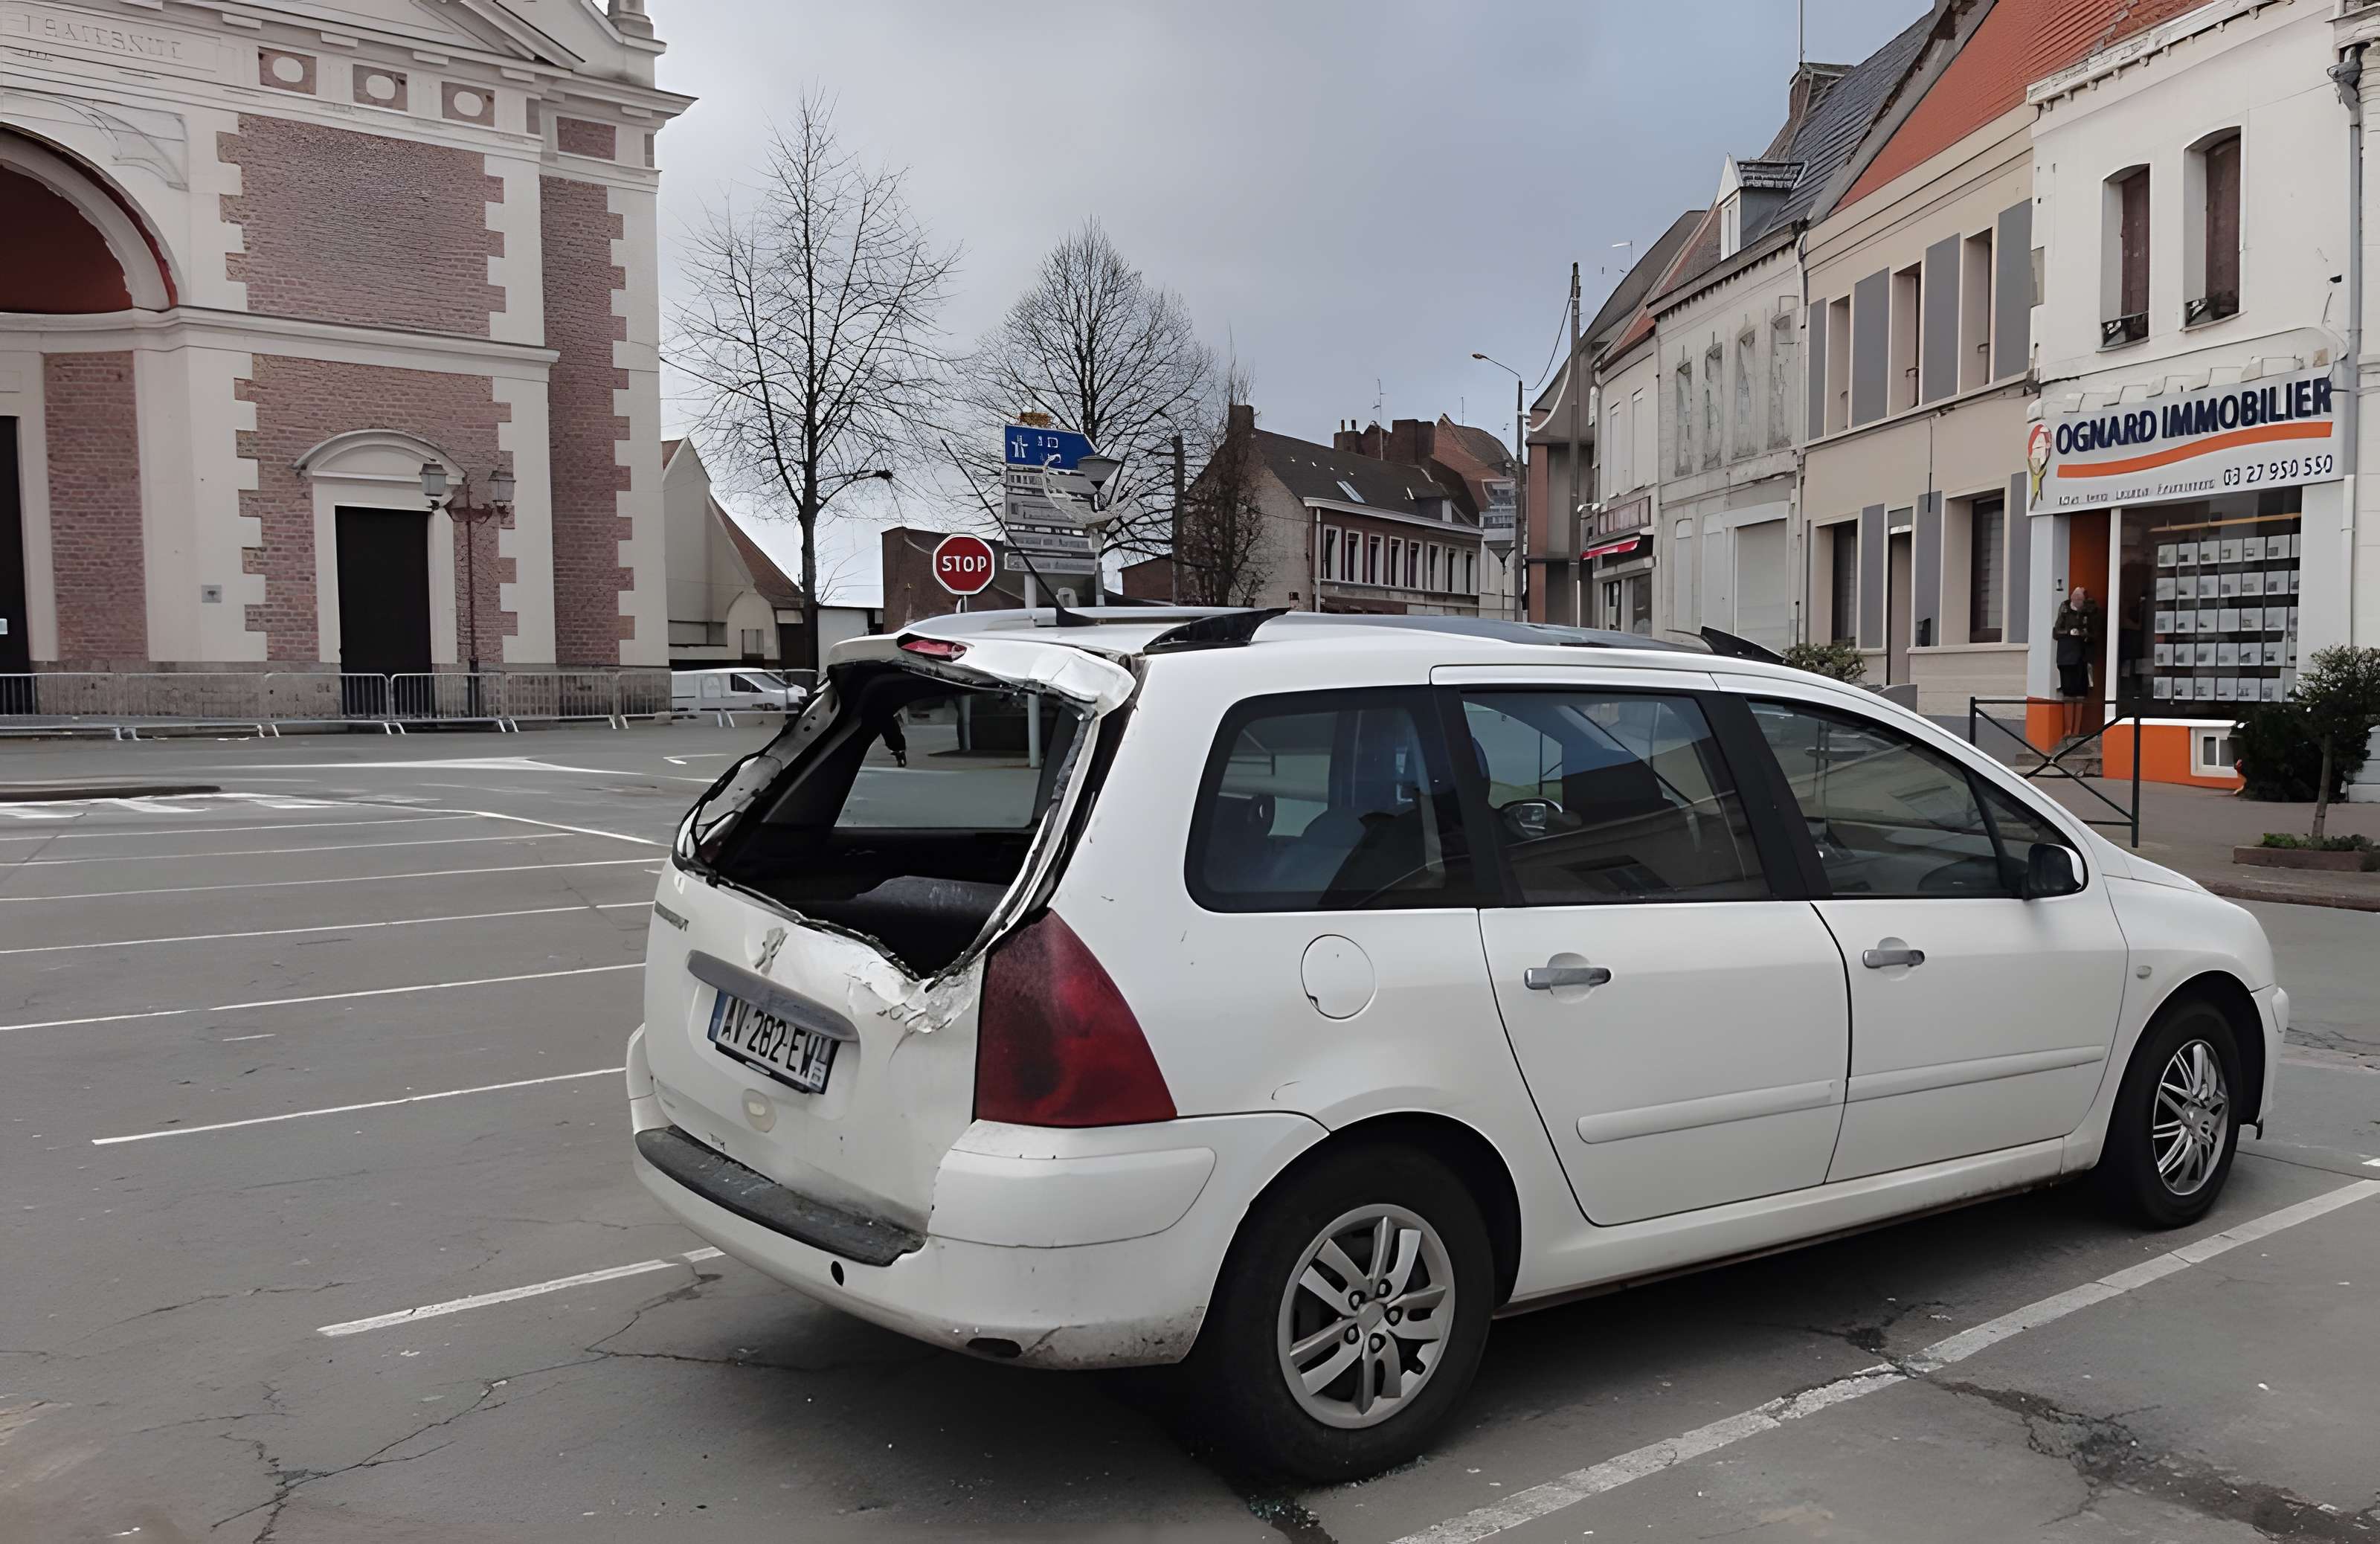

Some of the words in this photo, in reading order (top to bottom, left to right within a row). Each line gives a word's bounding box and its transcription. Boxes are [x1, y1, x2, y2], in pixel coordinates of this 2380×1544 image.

[2056, 410, 2157, 455] OGNARD
[2161, 376, 2332, 439] IMMOBILIER
[2303, 454, 2333, 477] 550
[942, 556, 987, 572] STOP
